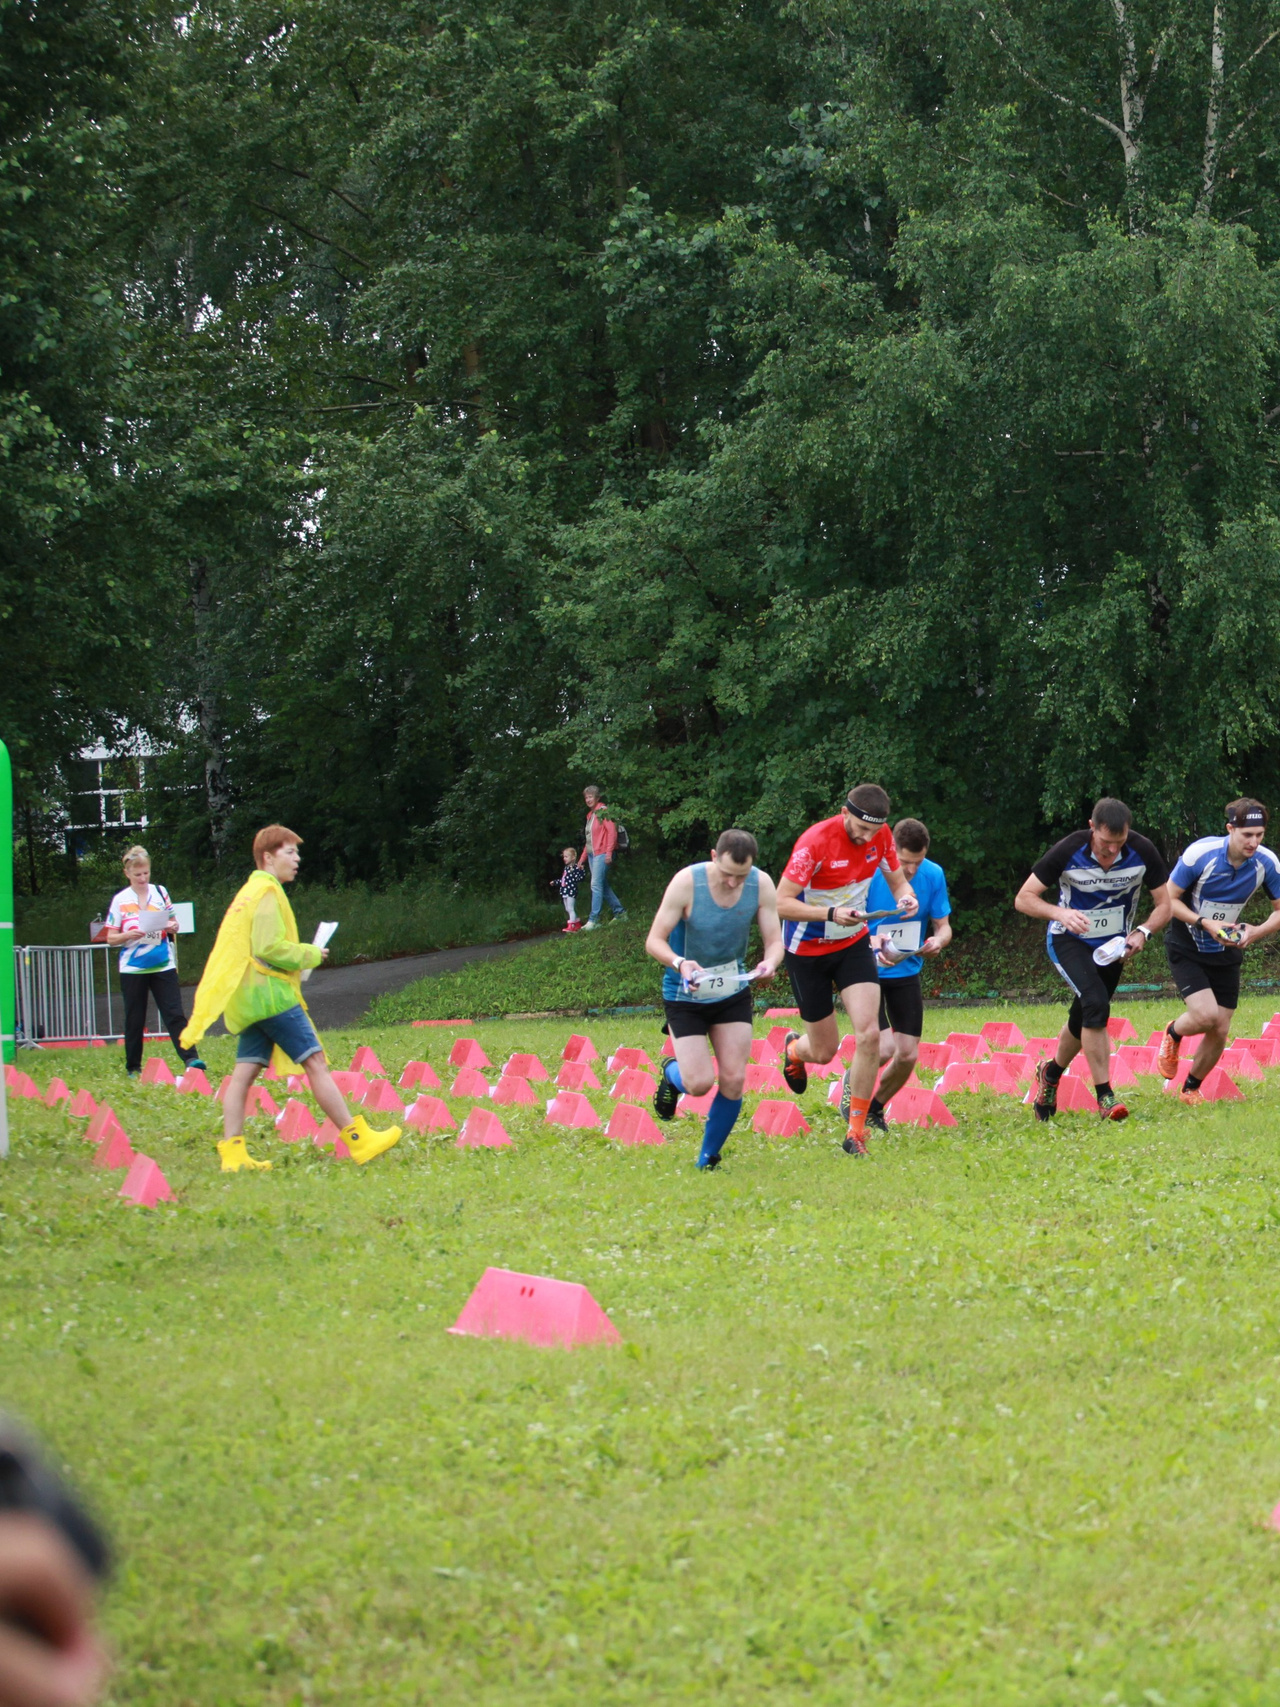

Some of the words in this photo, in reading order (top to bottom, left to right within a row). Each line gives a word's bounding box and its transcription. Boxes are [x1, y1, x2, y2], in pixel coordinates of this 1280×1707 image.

[1212, 912, 1226, 921] 69
[1093, 918, 1108, 928] 70
[891, 929, 903, 938] 71
[709, 977, 724, 989] 73
